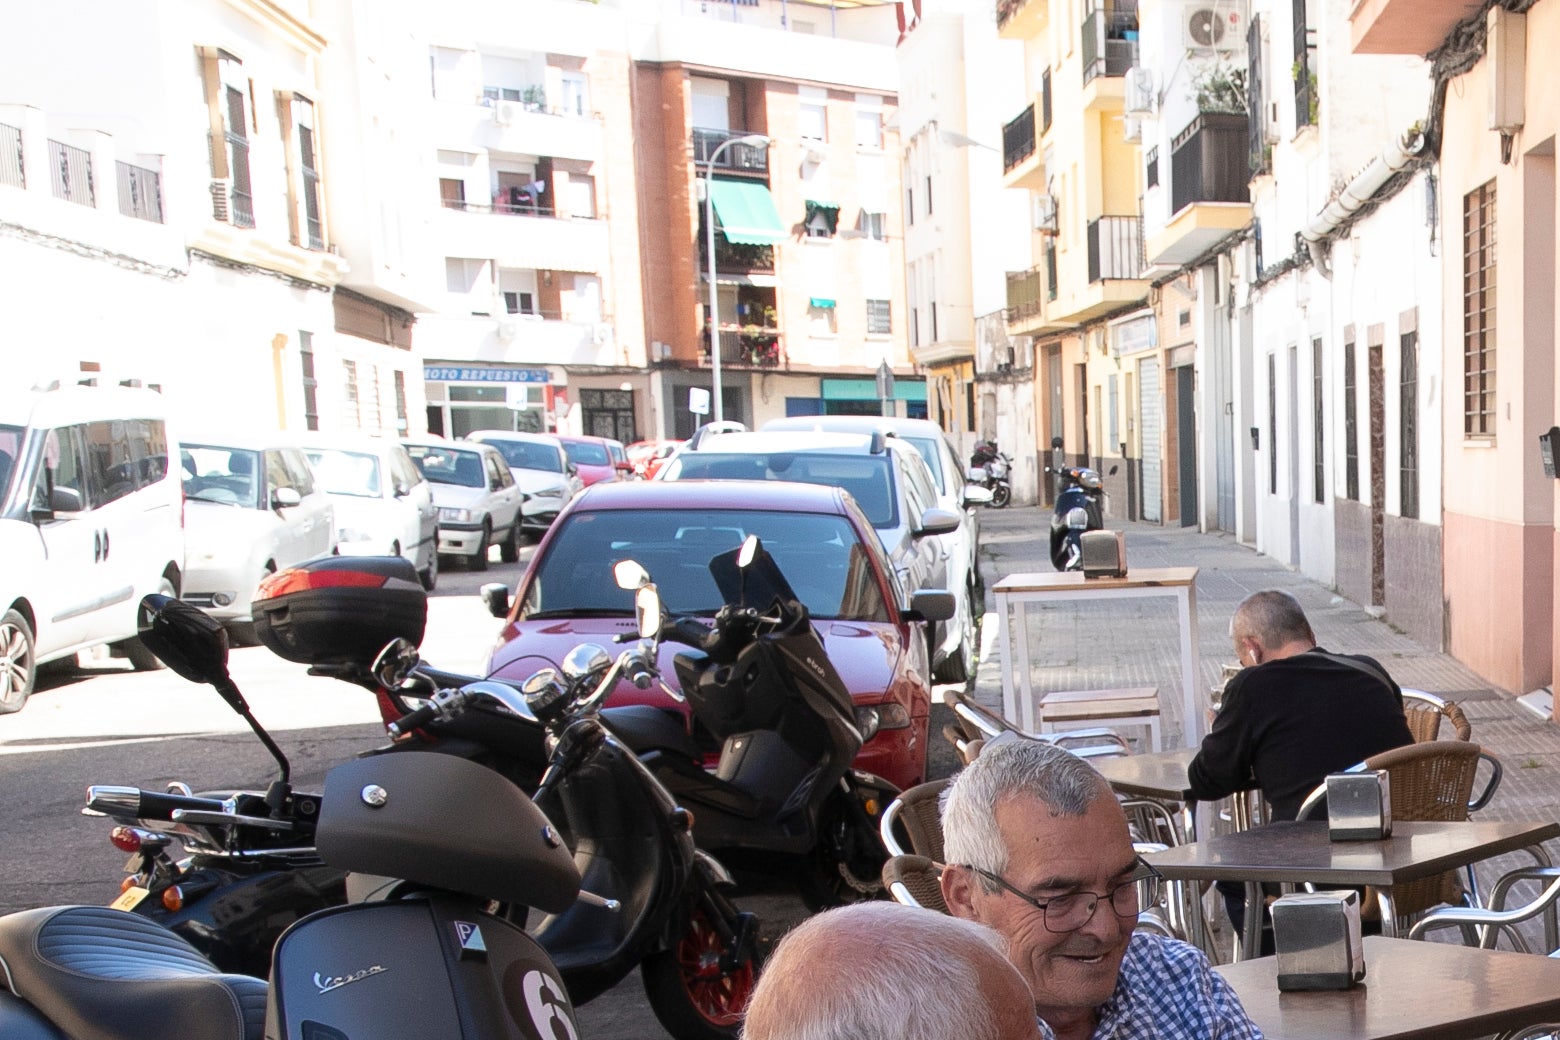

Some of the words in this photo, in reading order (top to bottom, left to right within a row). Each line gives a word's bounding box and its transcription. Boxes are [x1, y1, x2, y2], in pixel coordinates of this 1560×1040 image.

[460, 369, 528, 381] REPUESTO
[458, 923, 472, 940] P
[313, 965, 389, 994] Vespa
